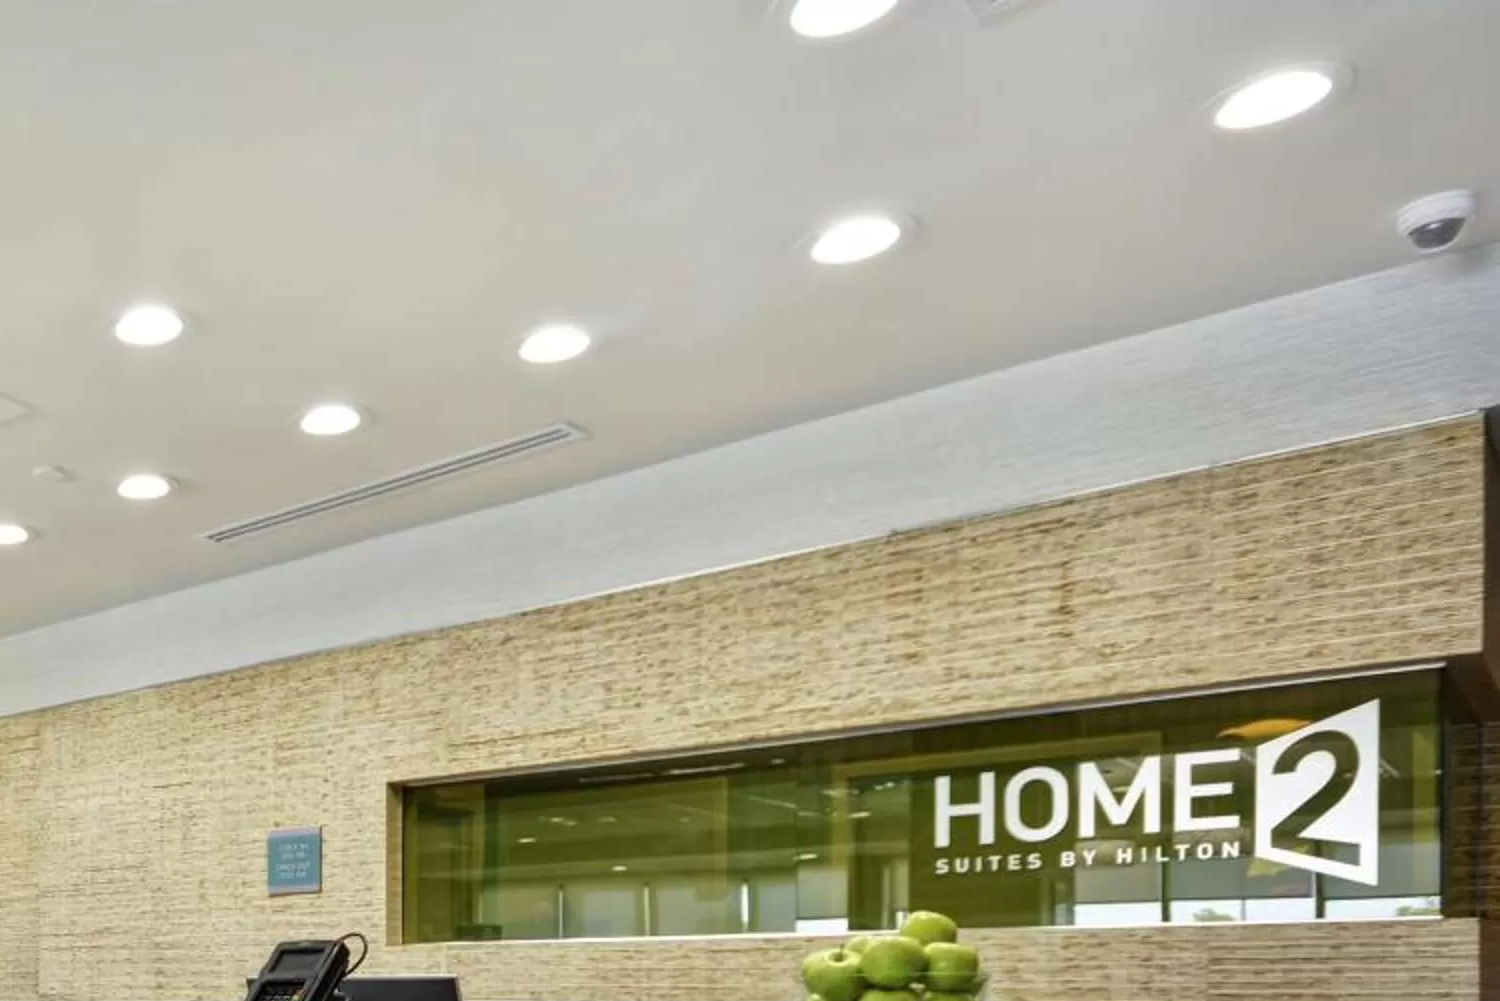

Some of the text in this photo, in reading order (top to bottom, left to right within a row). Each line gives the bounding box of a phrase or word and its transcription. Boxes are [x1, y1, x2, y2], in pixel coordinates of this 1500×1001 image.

[933, 840, 1241, 875] SUITES BY HILTON
